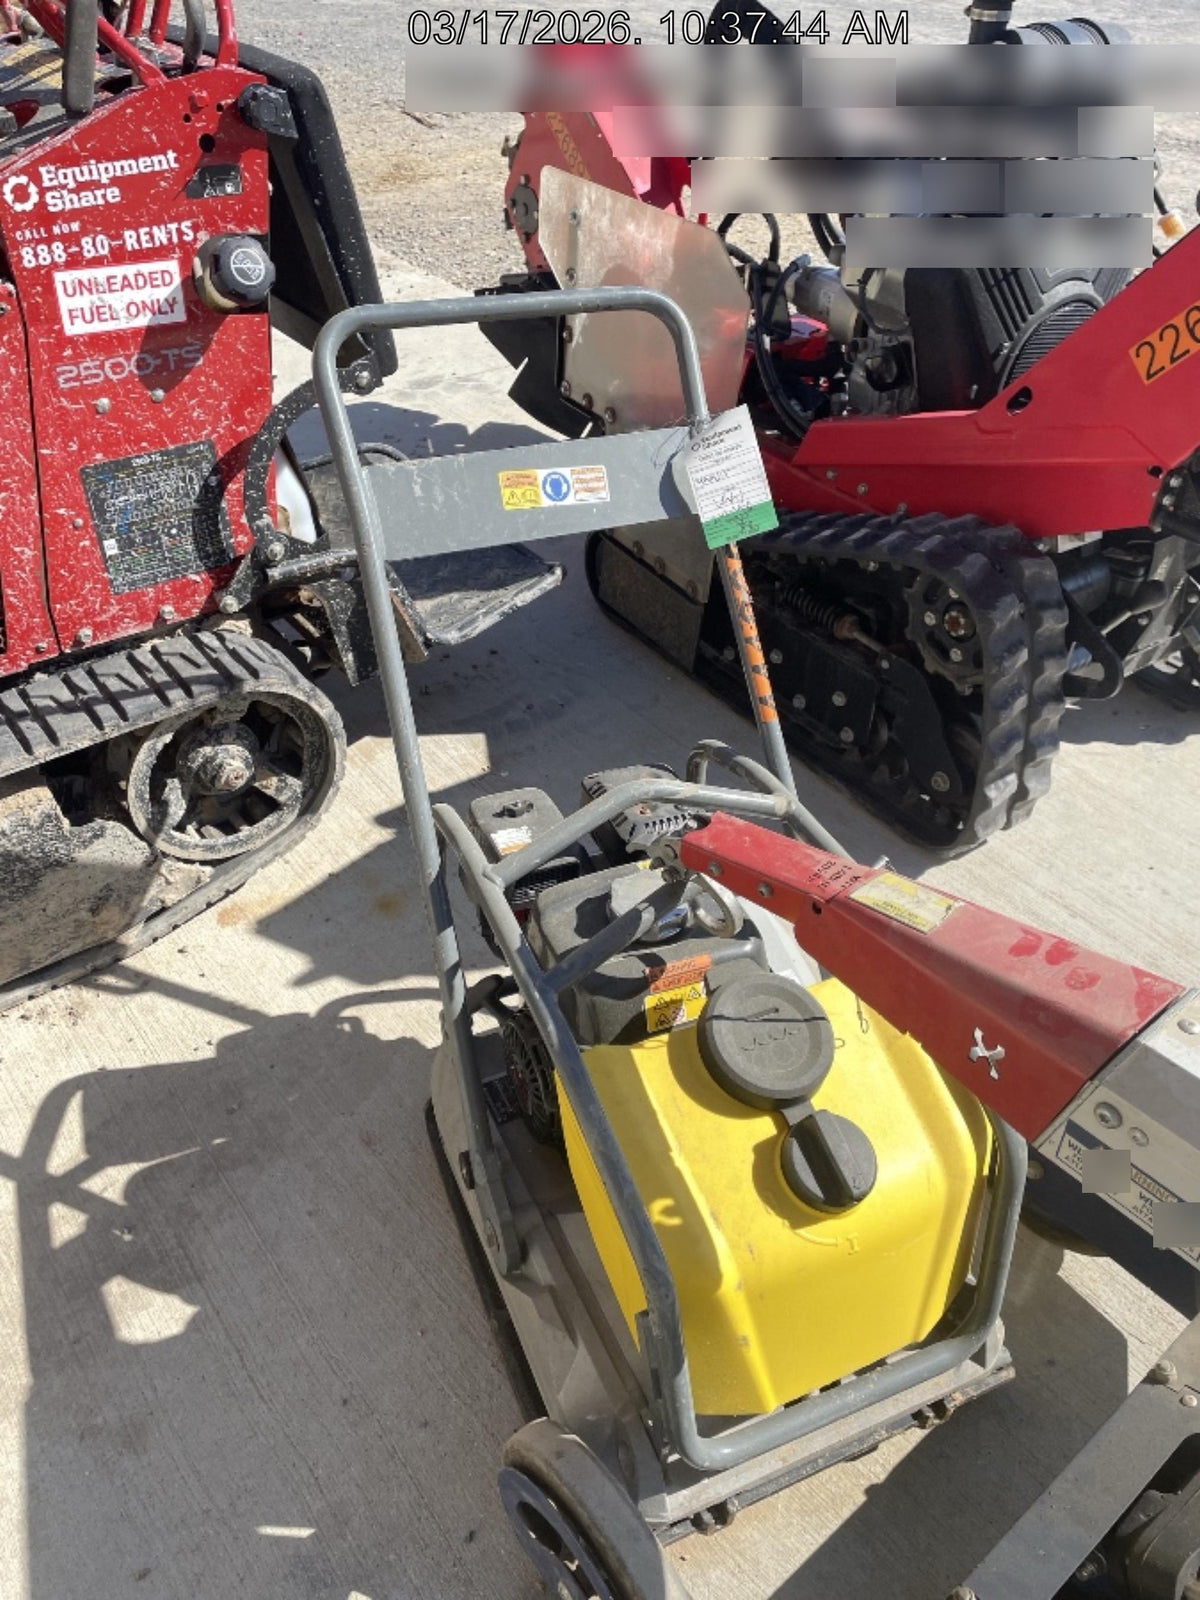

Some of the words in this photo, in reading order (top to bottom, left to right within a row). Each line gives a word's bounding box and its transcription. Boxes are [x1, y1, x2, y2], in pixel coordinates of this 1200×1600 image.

[39, 150, 179, 189] Equipment
[44, 187, 122, 213] Share
[15, 226, 49, 242] CALL
[52, 220, 82, 236] NOW
[21, 222, 195, 268] 888-80-RENTS
[61, 269, 174, 298] UNLEADED
[67, 305, 120, 327] FUEL
[125, 296, 178, 320] ONLY
